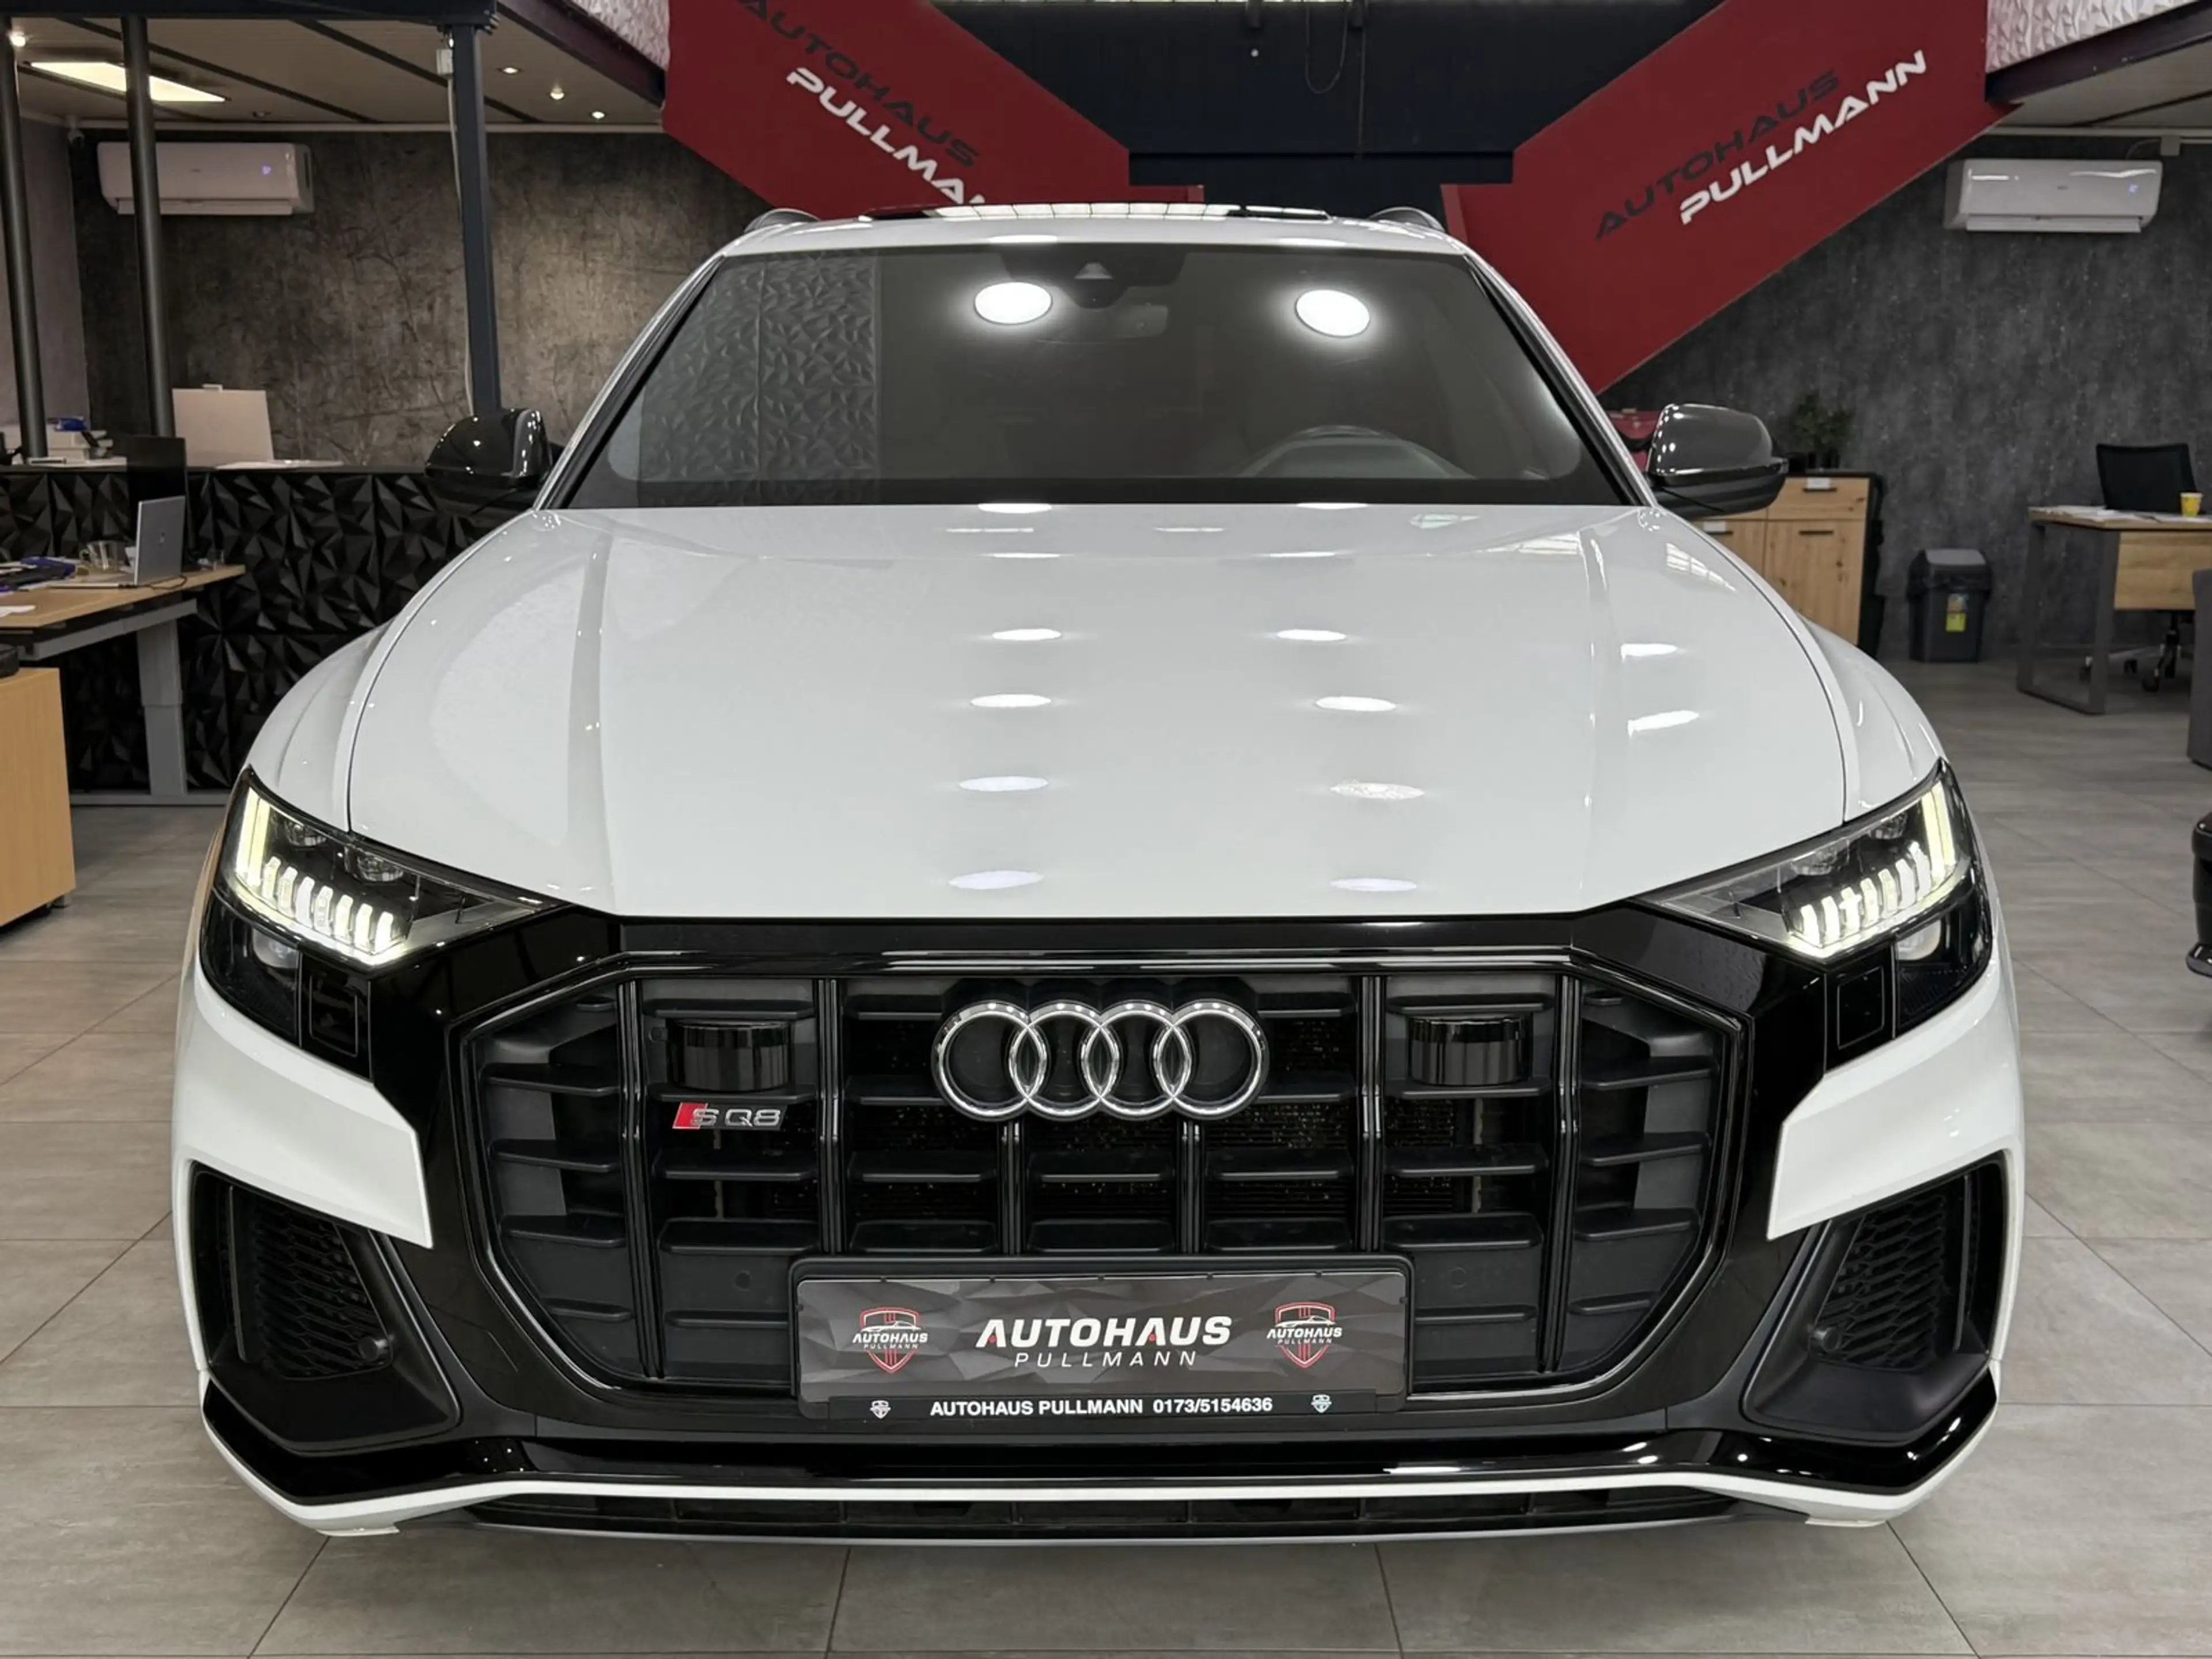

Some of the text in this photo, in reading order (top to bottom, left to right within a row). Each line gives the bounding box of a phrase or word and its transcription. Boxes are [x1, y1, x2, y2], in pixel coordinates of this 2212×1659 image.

[737, 0, 979, 167] AUTOHAUS
[786, 67, 985, 204] PULLMA
[1680, 50, 1927, 225] PULLMANN
[1595, 69, 1839, 240] AUTOHAUS
[852, 1332, 929, 1344] AUTOHAUS
[975, 1316, 1233, 1348] AUTOHAUS
[1266, 1327, 1343, 1339] AUTOHAUS
[1014, 1350, 1196, 1368] PULLMANN
[930, 1396, 1274, 1416] AUTOHAUS PULLMANN 0173/5154636
